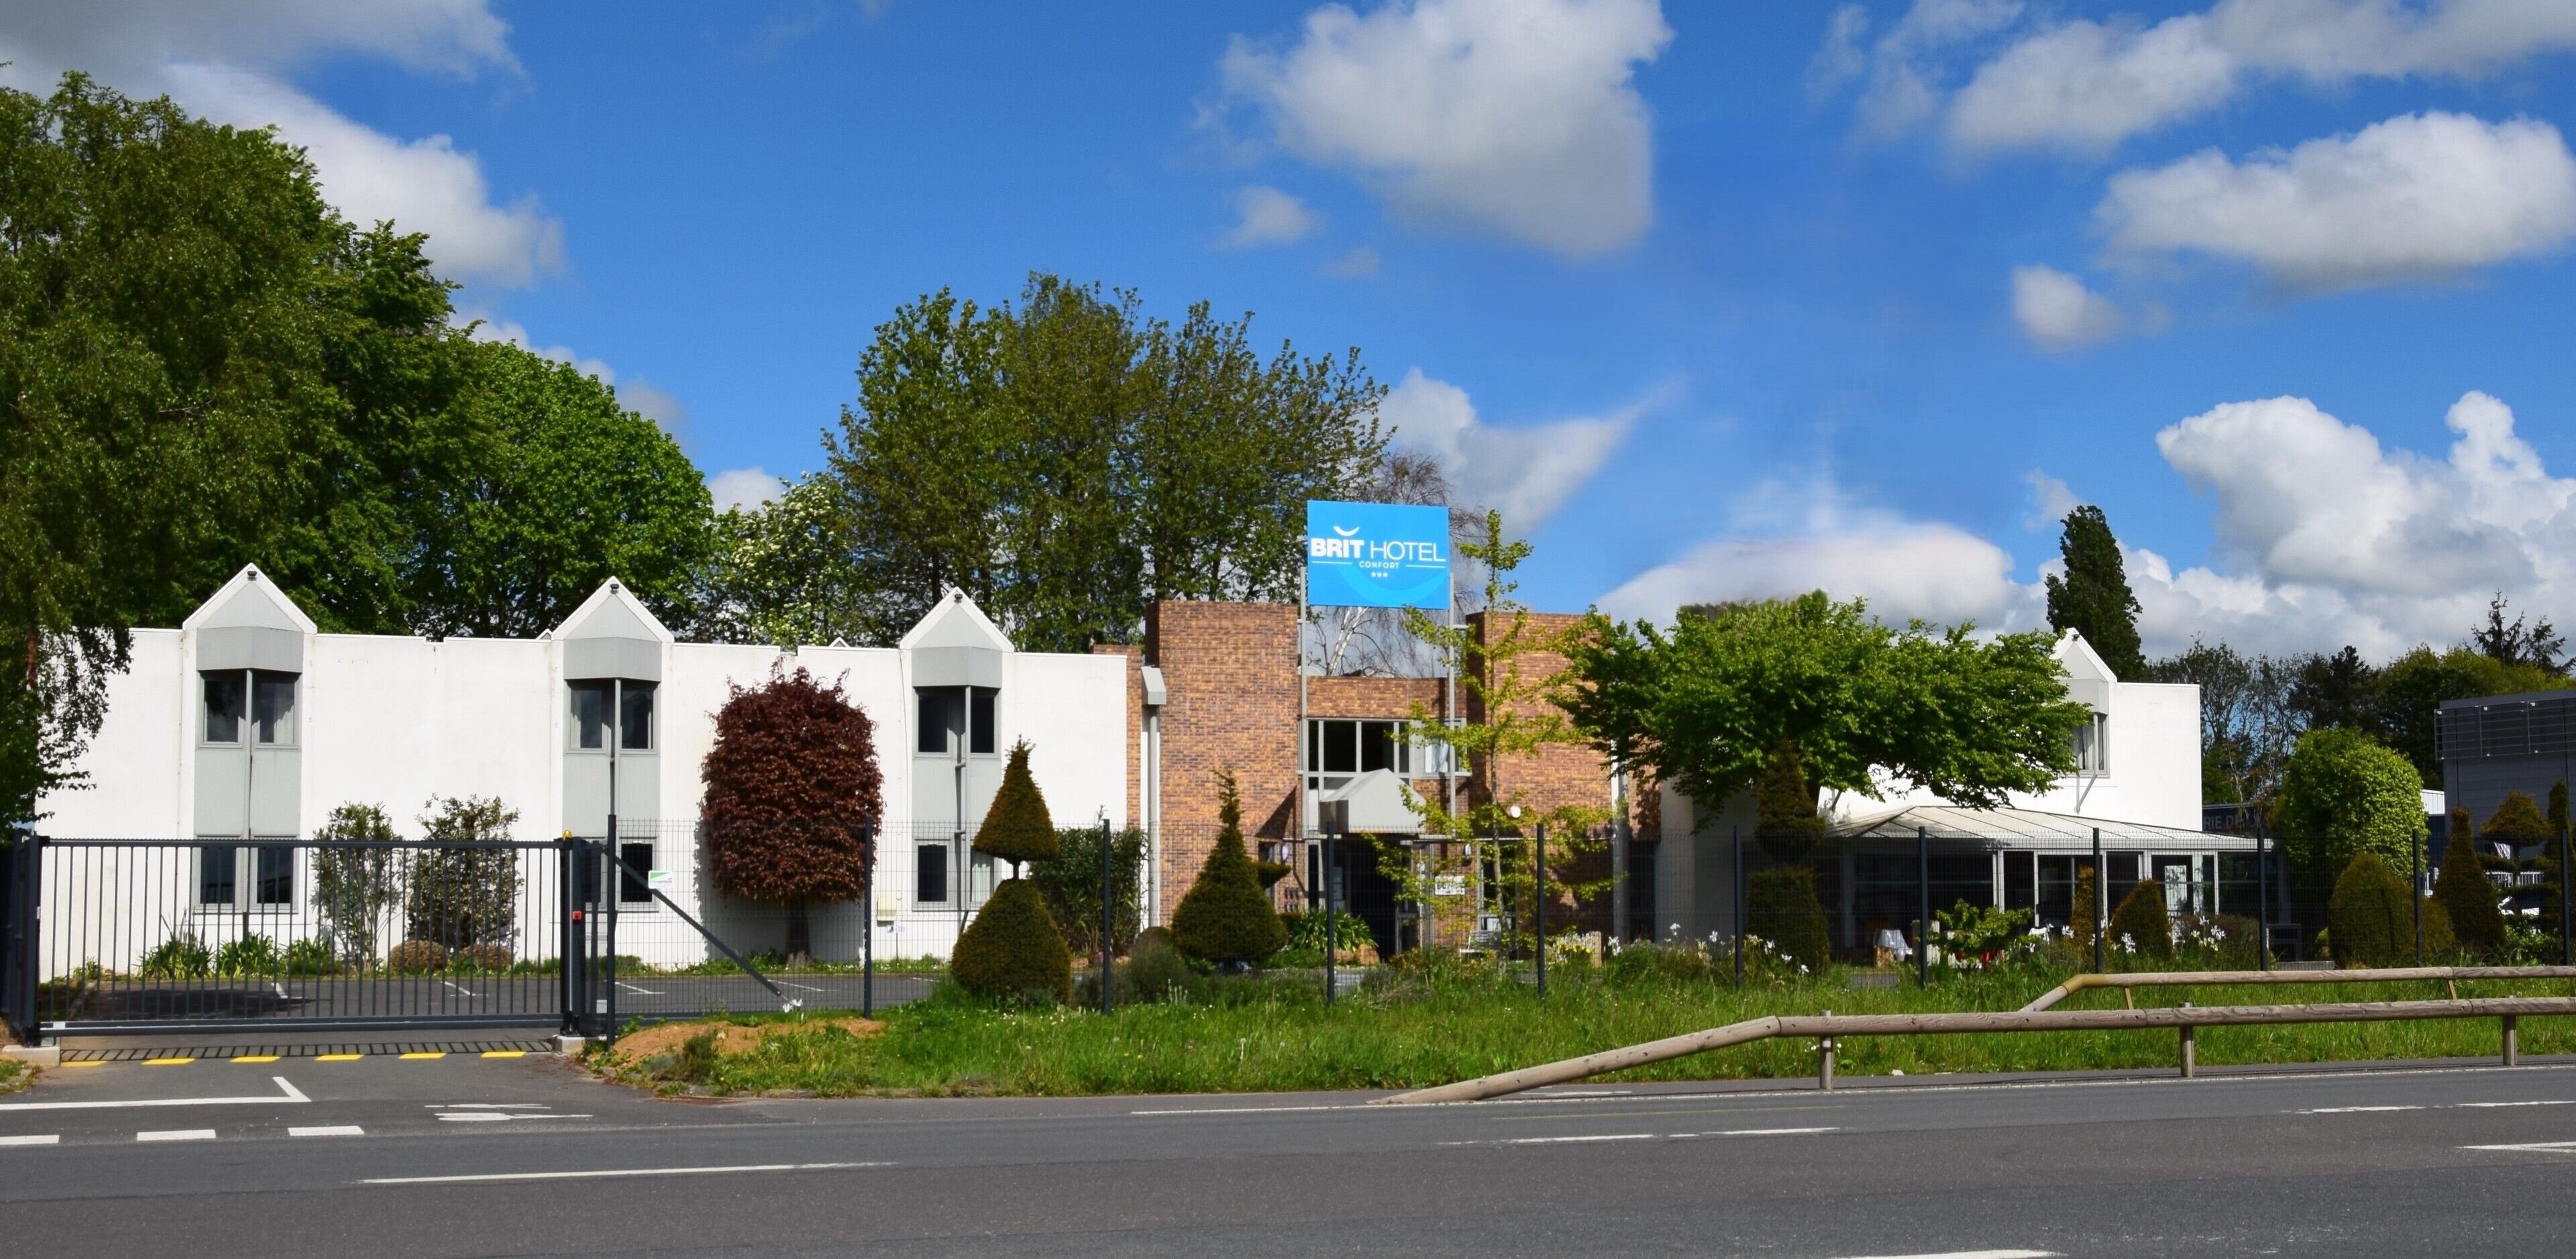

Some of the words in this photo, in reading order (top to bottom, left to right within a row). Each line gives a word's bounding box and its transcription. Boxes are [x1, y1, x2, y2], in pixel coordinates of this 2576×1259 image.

[1311, 537, 1364, 558] BRIT
[1371, 540, 1446, 562] HOTEL
[1359, 560, 1399, 569] CONFORT
